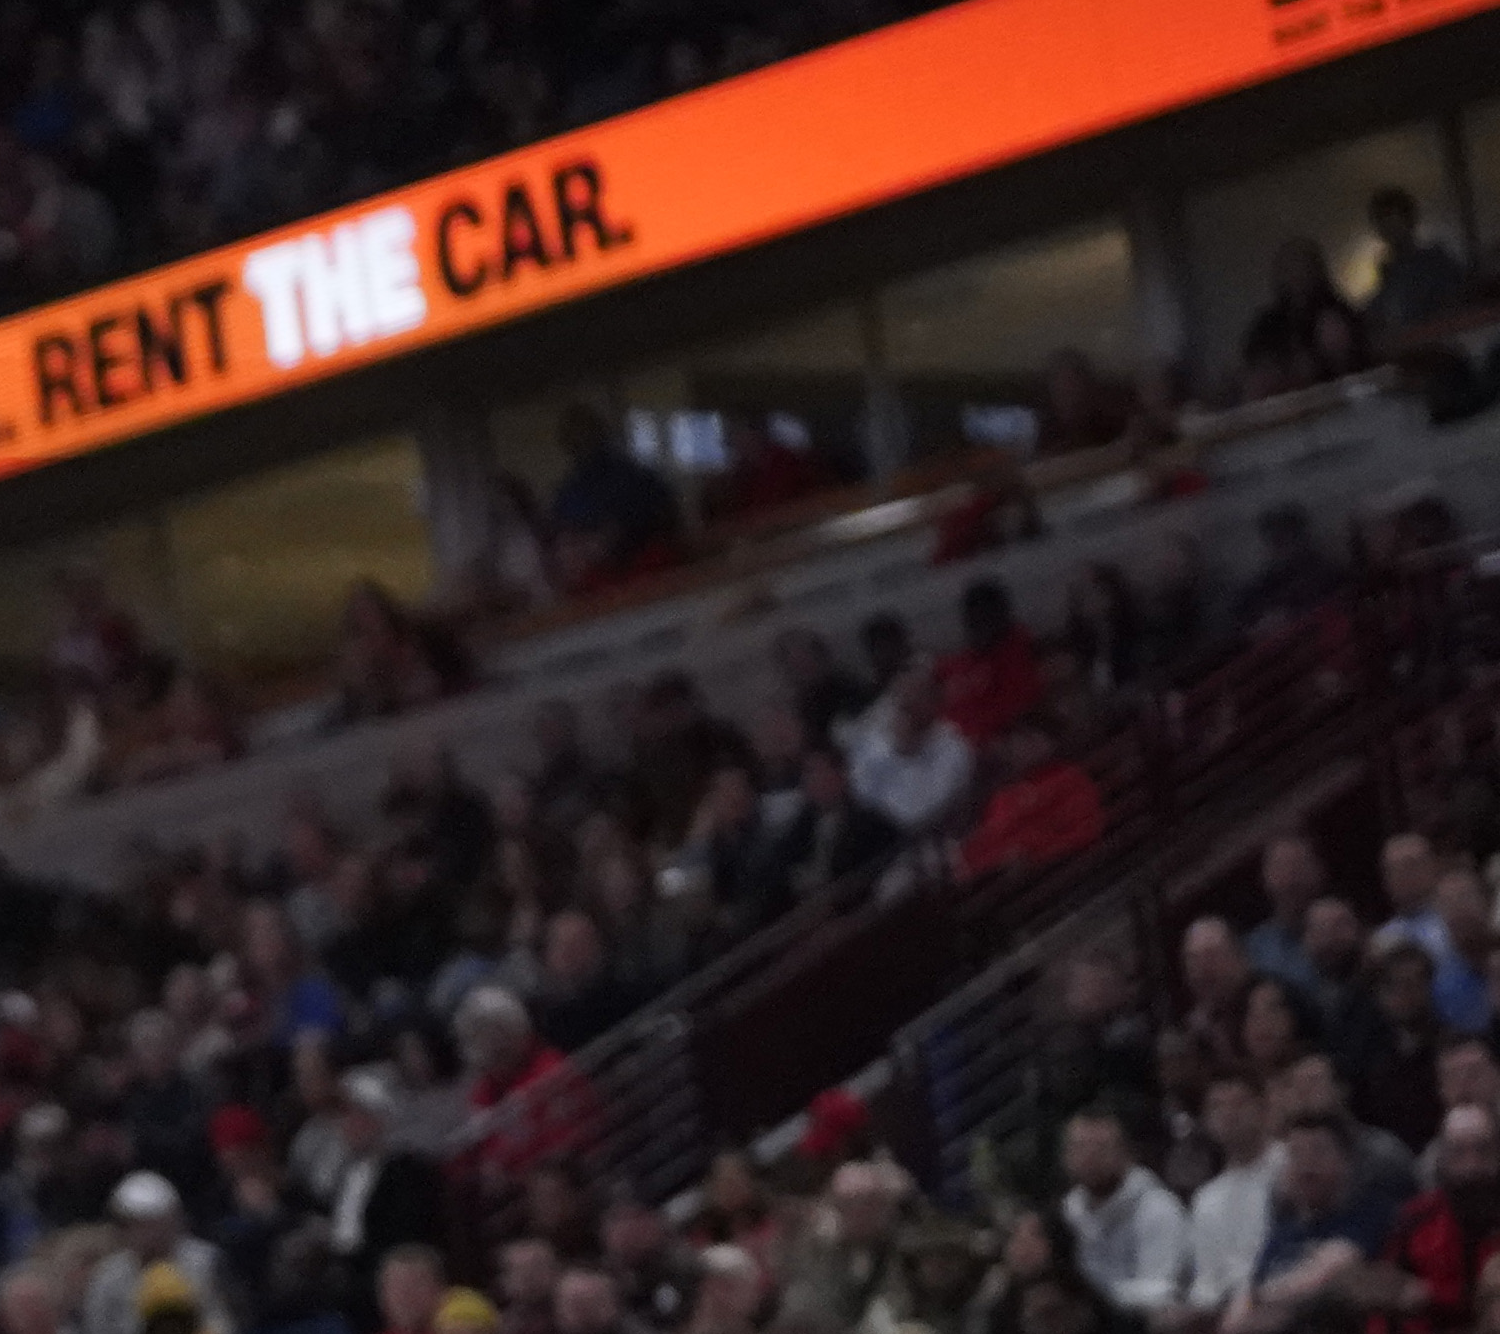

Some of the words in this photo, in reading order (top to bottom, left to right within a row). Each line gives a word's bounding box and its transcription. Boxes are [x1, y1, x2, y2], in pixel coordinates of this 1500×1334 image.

[34, 280, 232, 428] RENT
[242, 203, 427, 370] THE
[436, 159, 635, 300] CAR.
